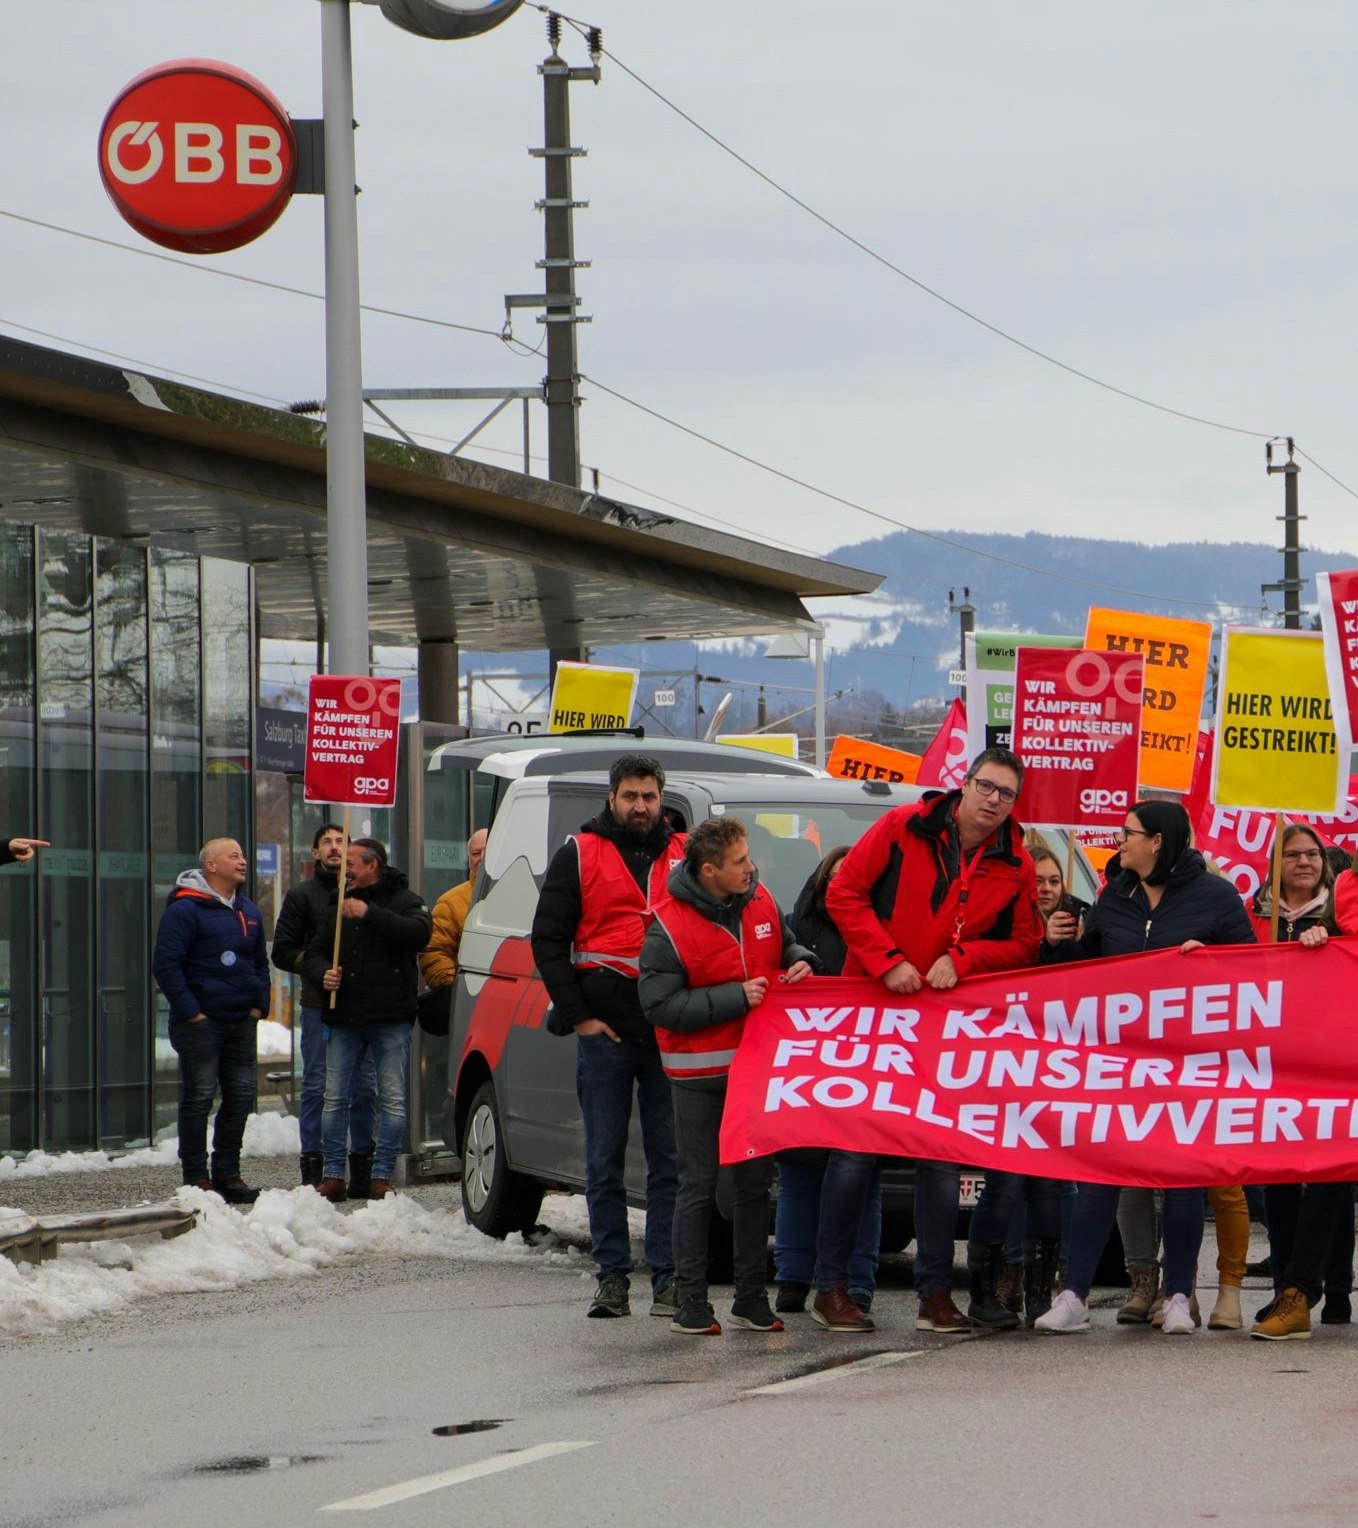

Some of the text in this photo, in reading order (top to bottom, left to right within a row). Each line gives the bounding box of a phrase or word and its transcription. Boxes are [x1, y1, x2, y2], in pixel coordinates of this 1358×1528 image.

[107, 120, 283, 186] ÖBB
[1024, 680, 1056, 694] WIR
[315, 698, 337, 709] WIR
[656, 693, 674, 703] 100
[1023, 697, 1101, 715] KÄMPFEN
[1227, 692, 1272, 717] HIER
[314, 710, 370, 724] KÄMPFEN
[553, 709, 586, 729] HIER
[590, 713, 625, 729] WIRD
[1022, 715, 1133, 736] FÜR UNSEREN
[264, 720, 293, 749] Salzburg
[313, 724, 393, 739] FÜR UNSEREN
[1223, 726, 1337, 755] GESTREIKT!
[312, 738, 379, 751] KOLLEKTIV-
[1022, 736, 1115, 753] KOLLEKTIV-
[312, 752, 365, 764] VERTRAG
[1021, 755, 1094, 771] VERTRAG
[353, 776, 389, 795] gpa
[1079, 788, 1128, 814] gpa
[784, 980, 1284, 1047] WIR KÄMPFEN
[772, 1035, 1273, 1090] FÜR UNSEREN
